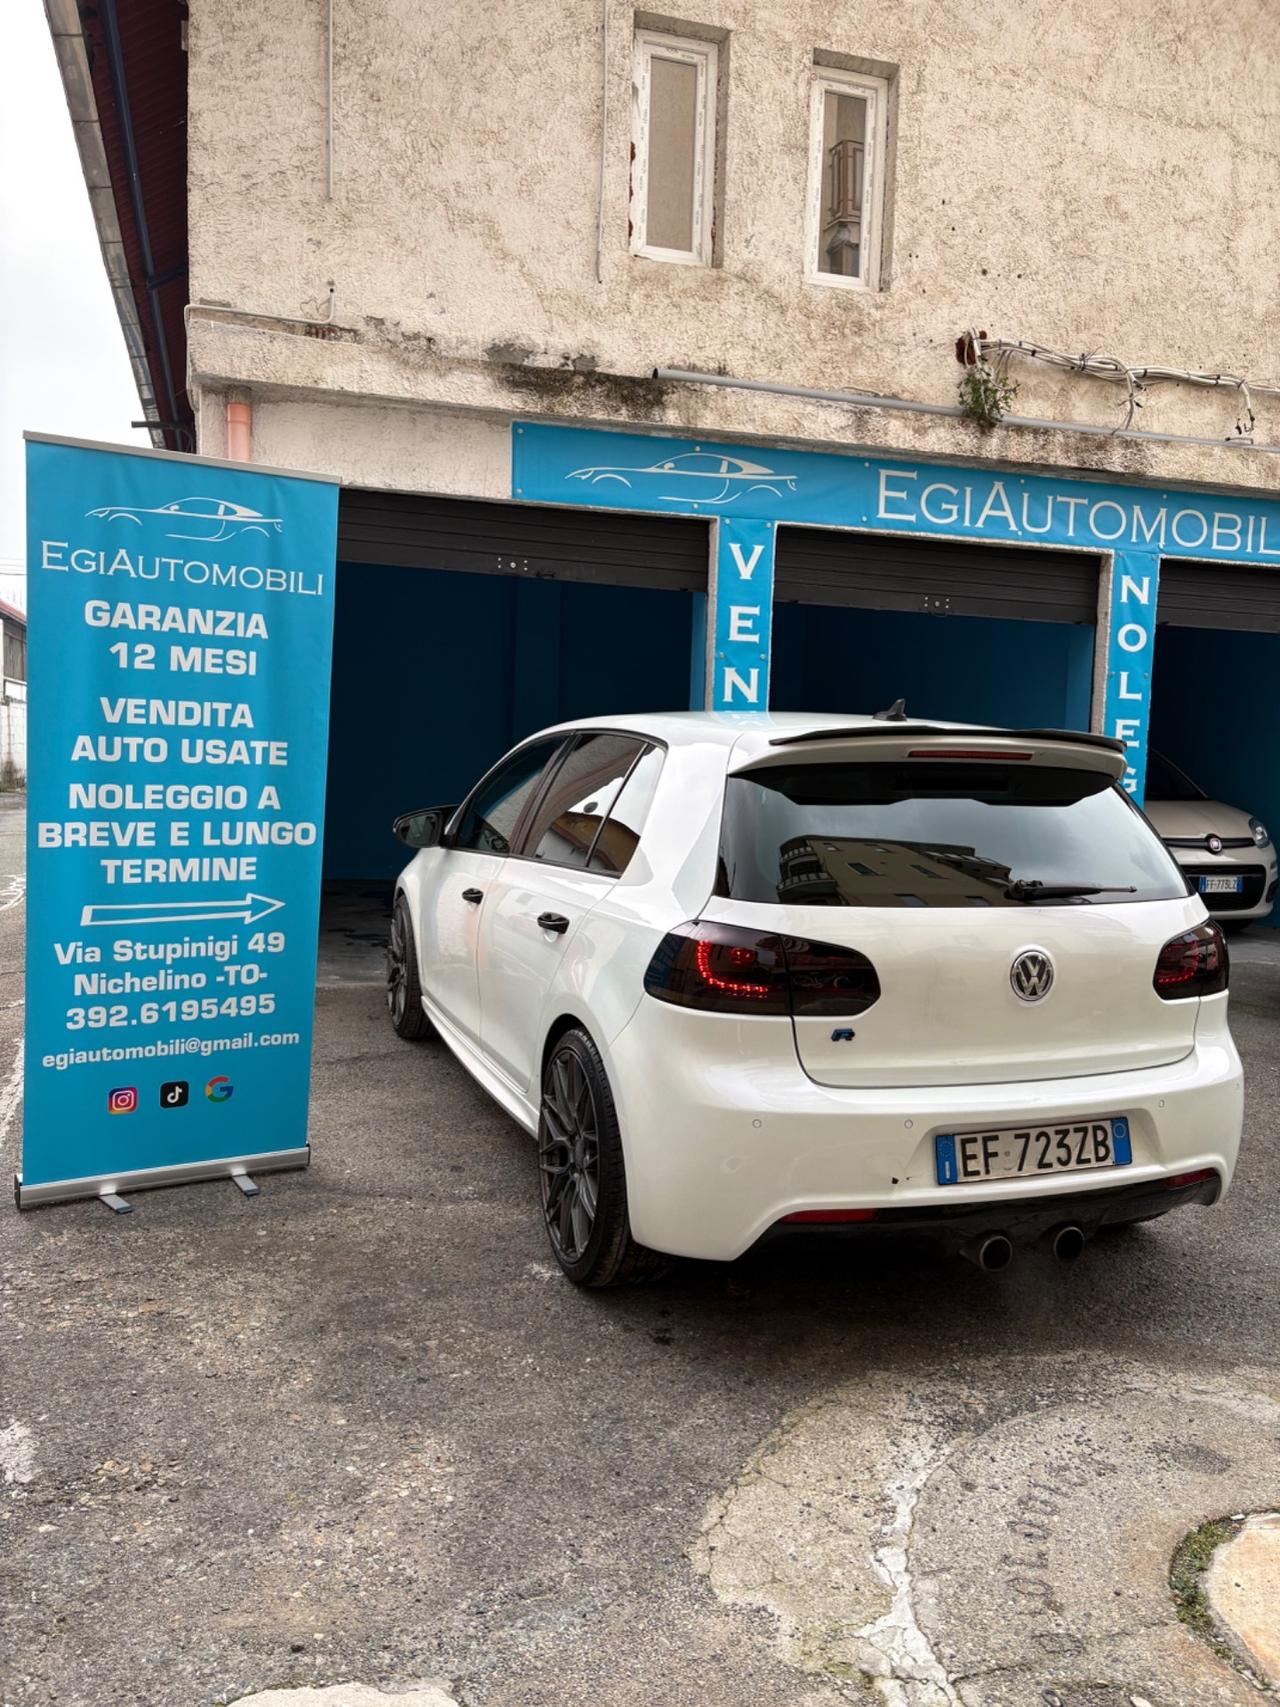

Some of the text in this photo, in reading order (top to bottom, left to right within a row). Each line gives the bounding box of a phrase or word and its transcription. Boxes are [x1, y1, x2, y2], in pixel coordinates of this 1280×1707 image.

[84, 599, 269, 639] GARANZIA
[723, 542, 765, 712] VEN
[109, 642, 257, 676] 12 MESI
[100, 696, 254, 728] VENDITA
[71, 735, 288, 766] AUTO USATE
[69, 783, 282, 810] NOLEGGIO A
[38, 821, 317, 848] BREVE E LUNGO
[100, 856, 257, 884] TERMINE
[54, 932, 286, 965] Via Stupinigi 49
[74, 963, 268, 996] Nichelino -TO-
[66, 993, 276, 1030] 392.6195495
[42, 1031, 300, 1070] egiautomobili@gmail.com
